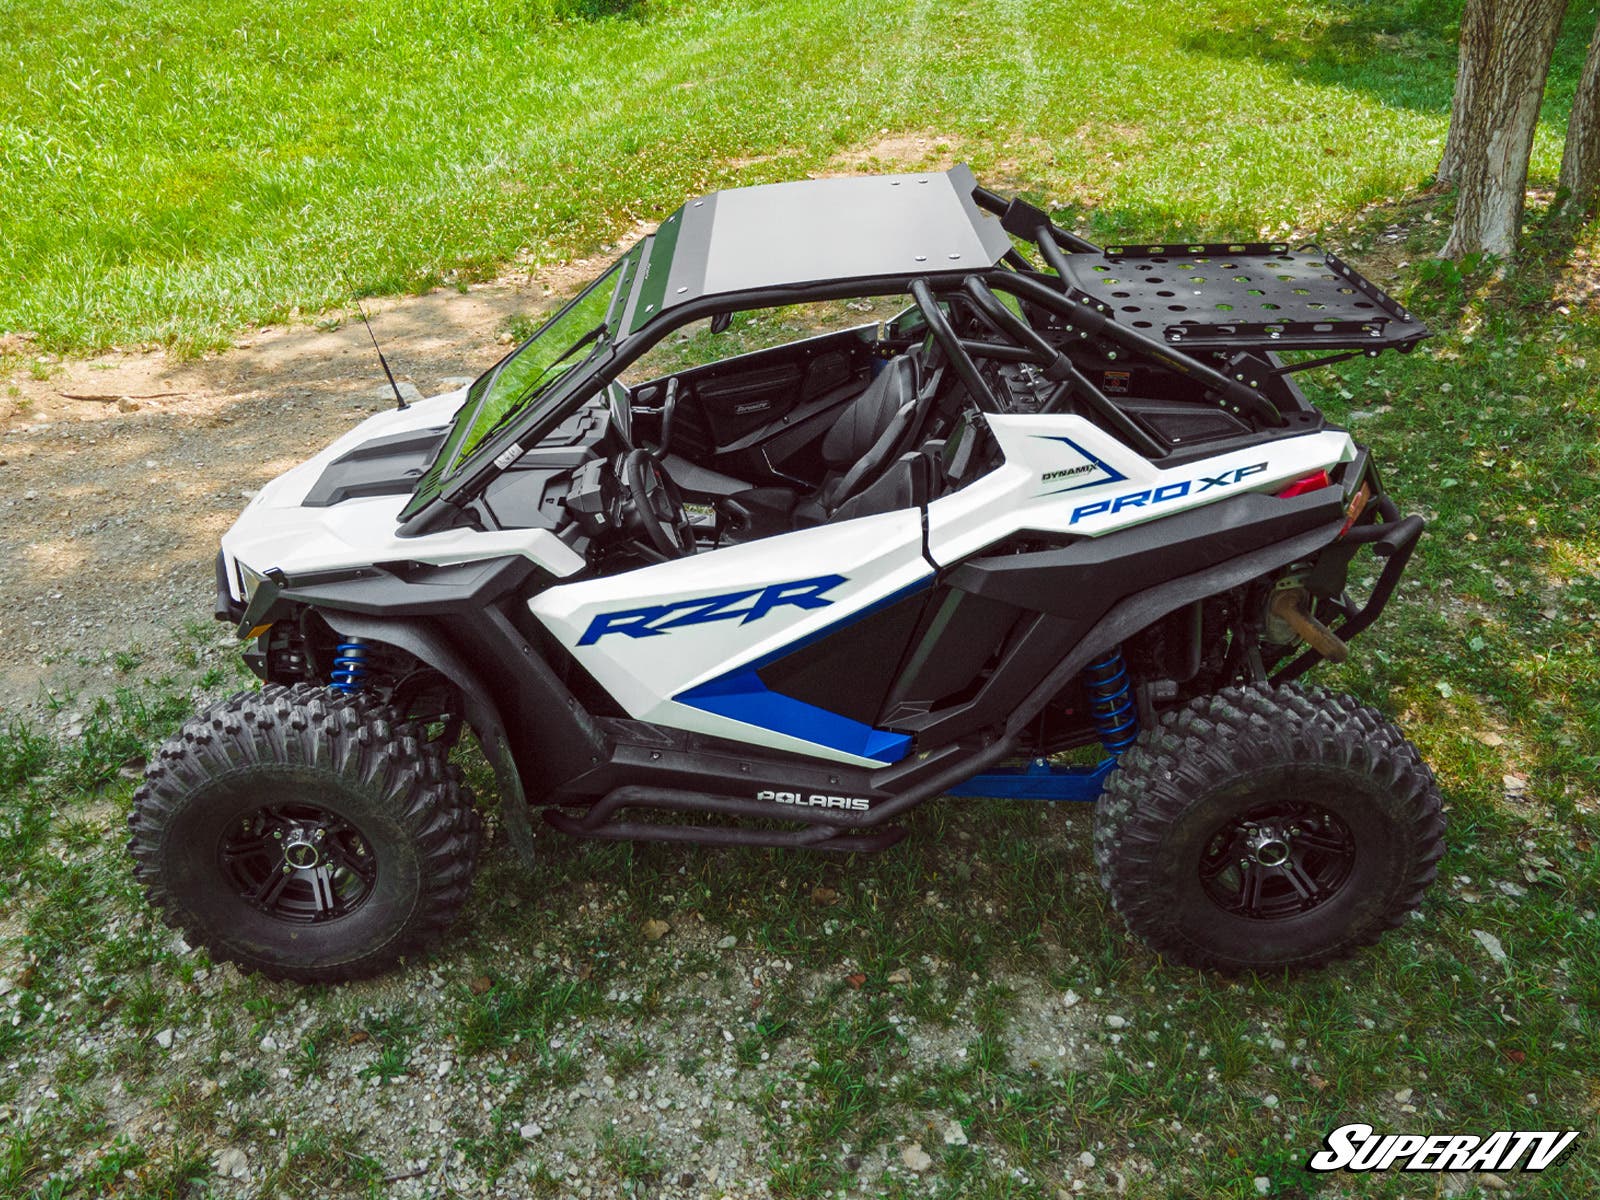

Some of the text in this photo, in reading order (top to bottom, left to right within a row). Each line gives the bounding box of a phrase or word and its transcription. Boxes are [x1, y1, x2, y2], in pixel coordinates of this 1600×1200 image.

[1041, 459, 1099, 481] DYNAMIX
[1069, 461, 1269, 525] PRO XP
[575, 573, 851, 647] RZR
[757, 790, 870, 811] POLARIS
